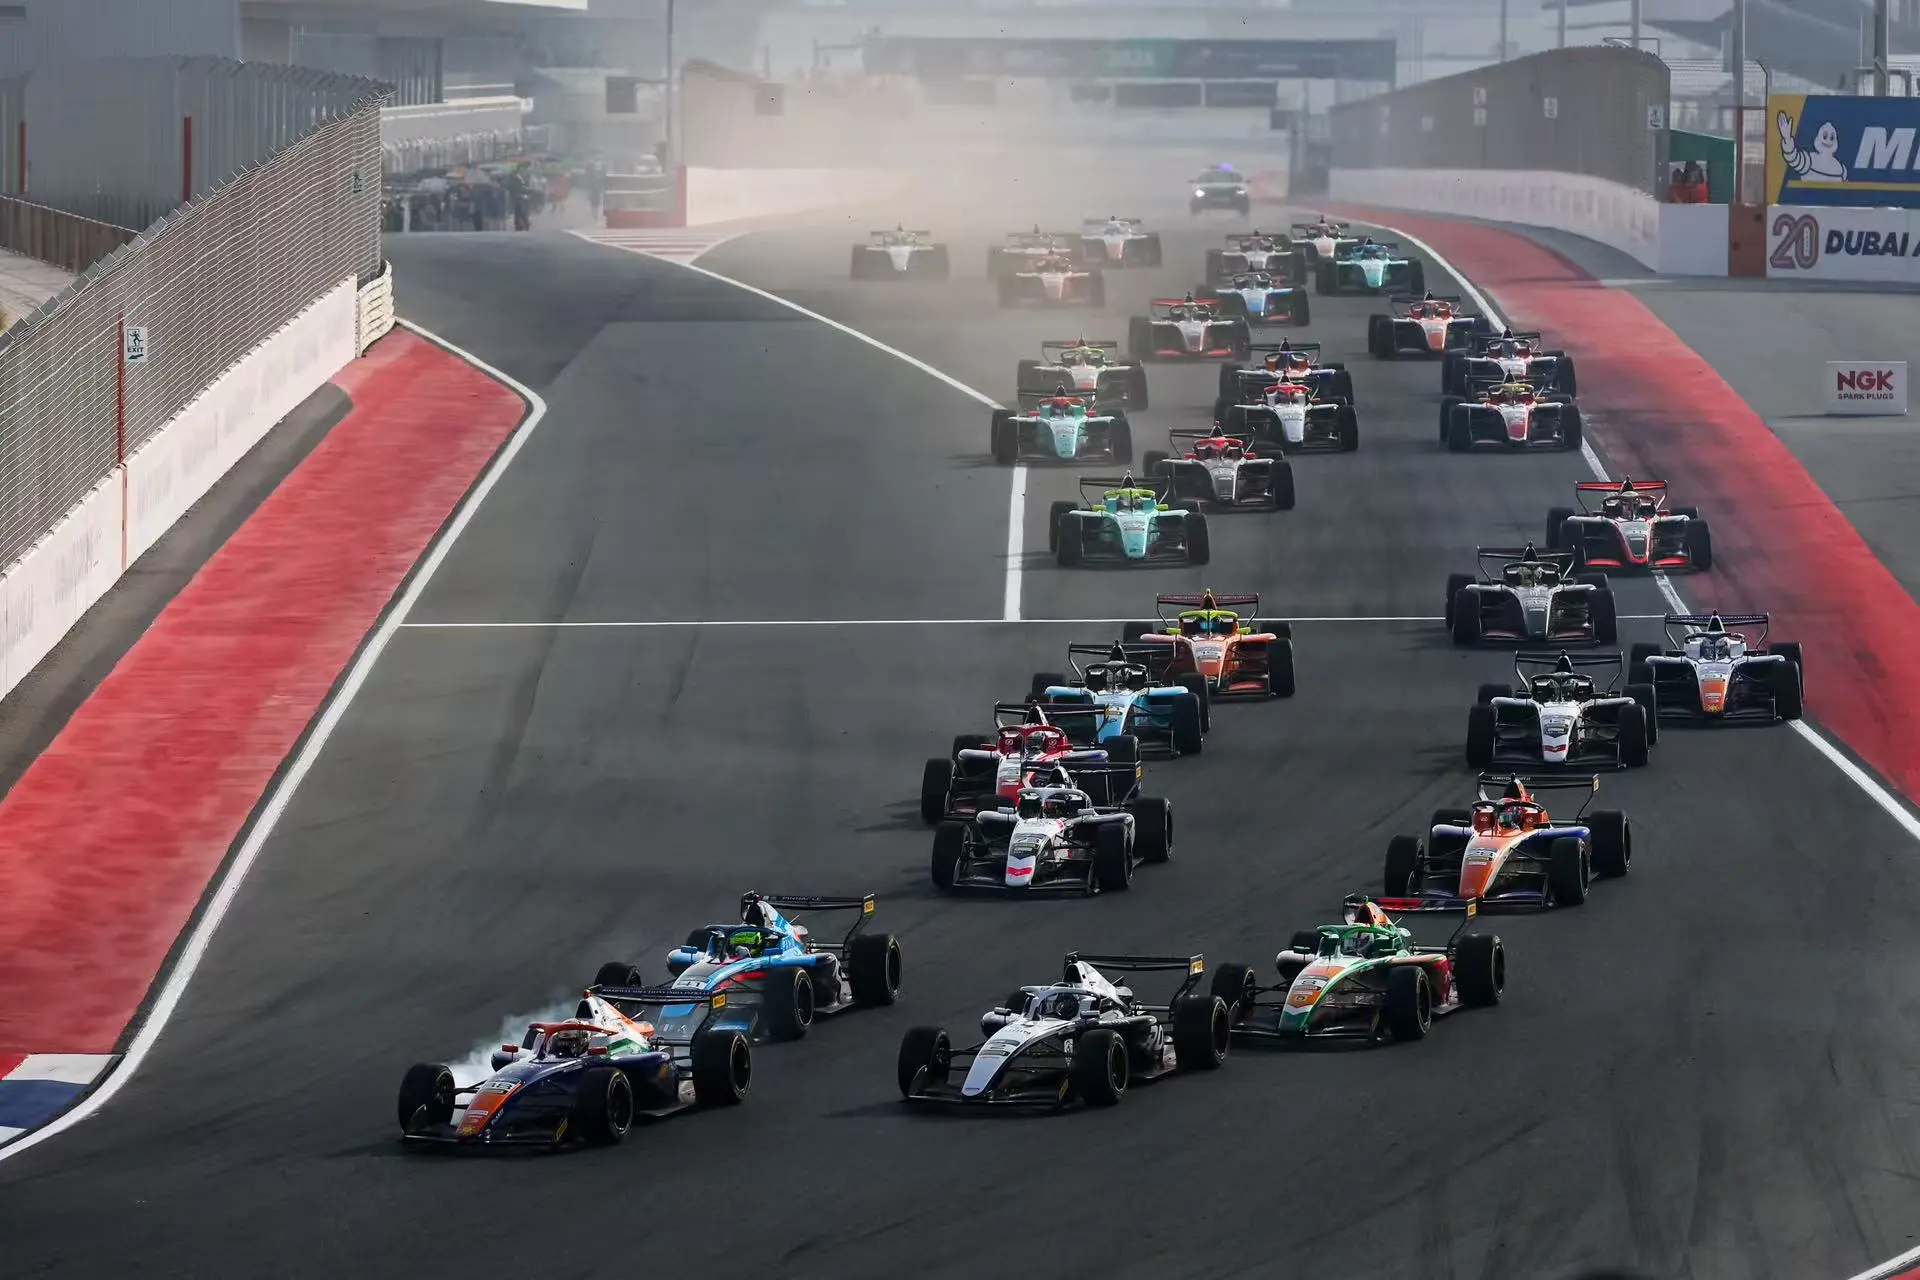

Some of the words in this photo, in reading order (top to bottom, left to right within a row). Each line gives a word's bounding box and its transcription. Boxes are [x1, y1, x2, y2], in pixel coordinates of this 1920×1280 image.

[1770, 213, 1819, 269] 20
[1825, 230, 1909, 257] DUBAI
[1837, 370, 1894, 391] NGK
